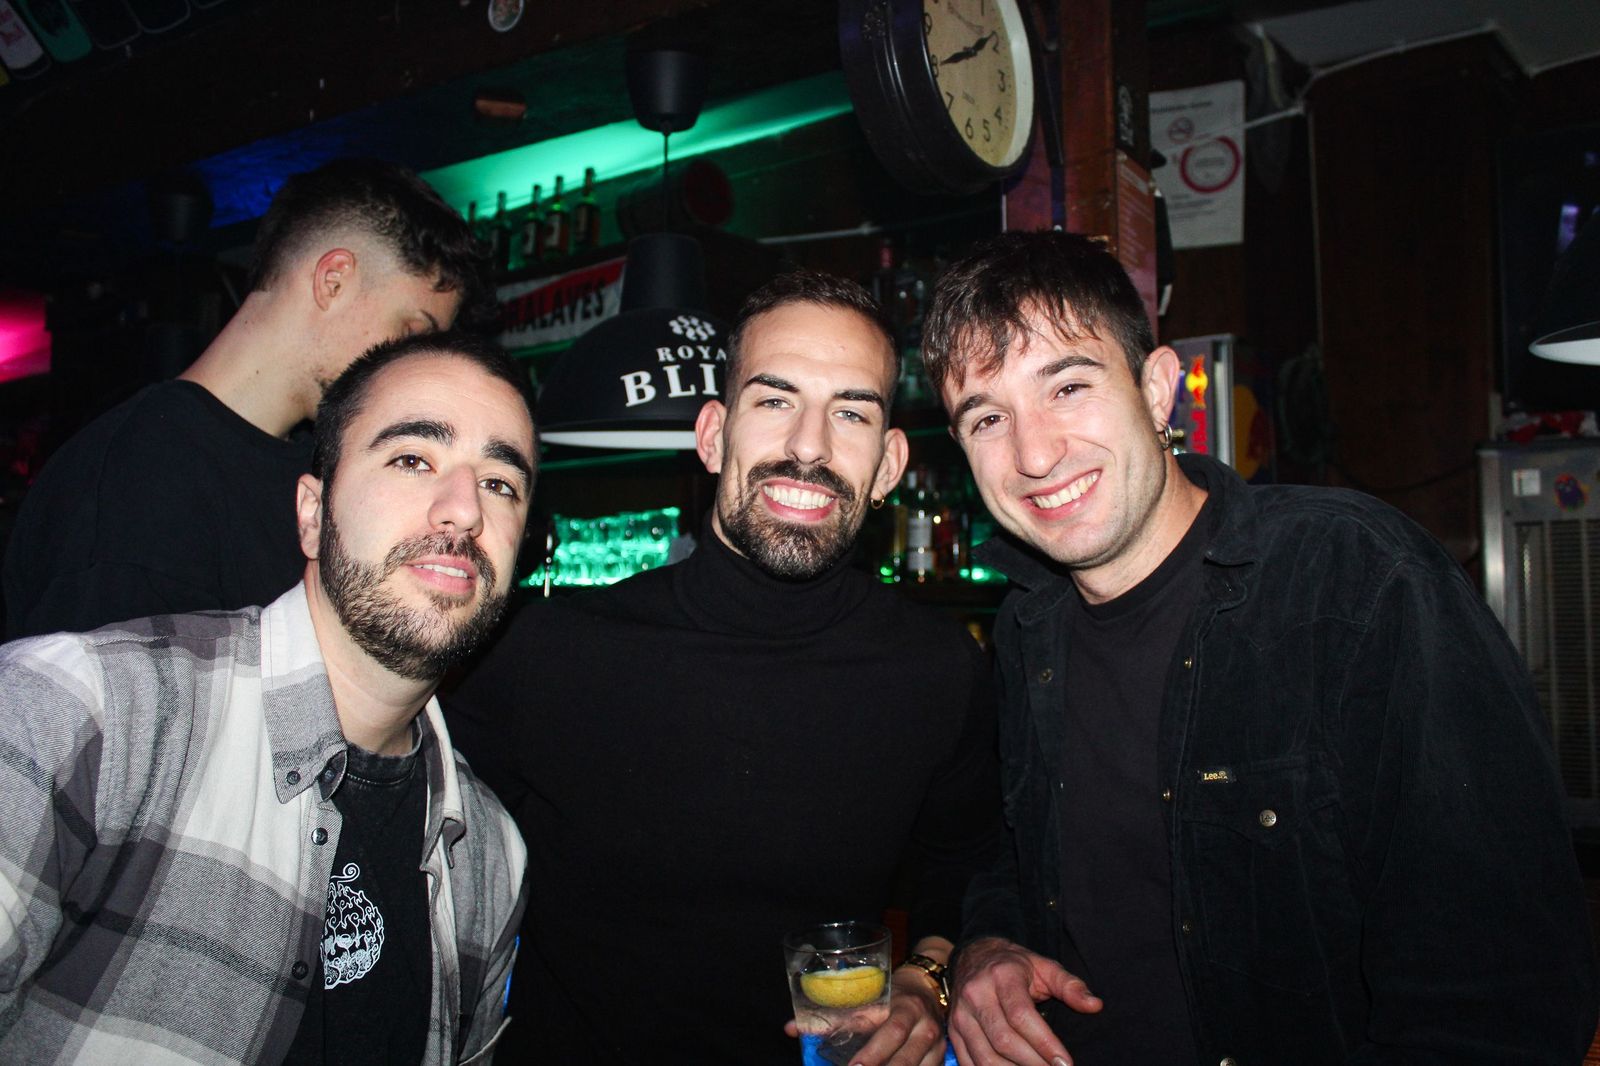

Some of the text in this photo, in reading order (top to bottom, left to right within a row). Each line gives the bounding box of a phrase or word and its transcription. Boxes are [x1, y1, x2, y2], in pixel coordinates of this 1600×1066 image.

[997, 69, 1006, 92] 3
[945, 91, 955, 110] 7
[994, 106, 1003, 126] 4
[964, 118, 975, 140] 6
[982, 119, 992, 142] 5
